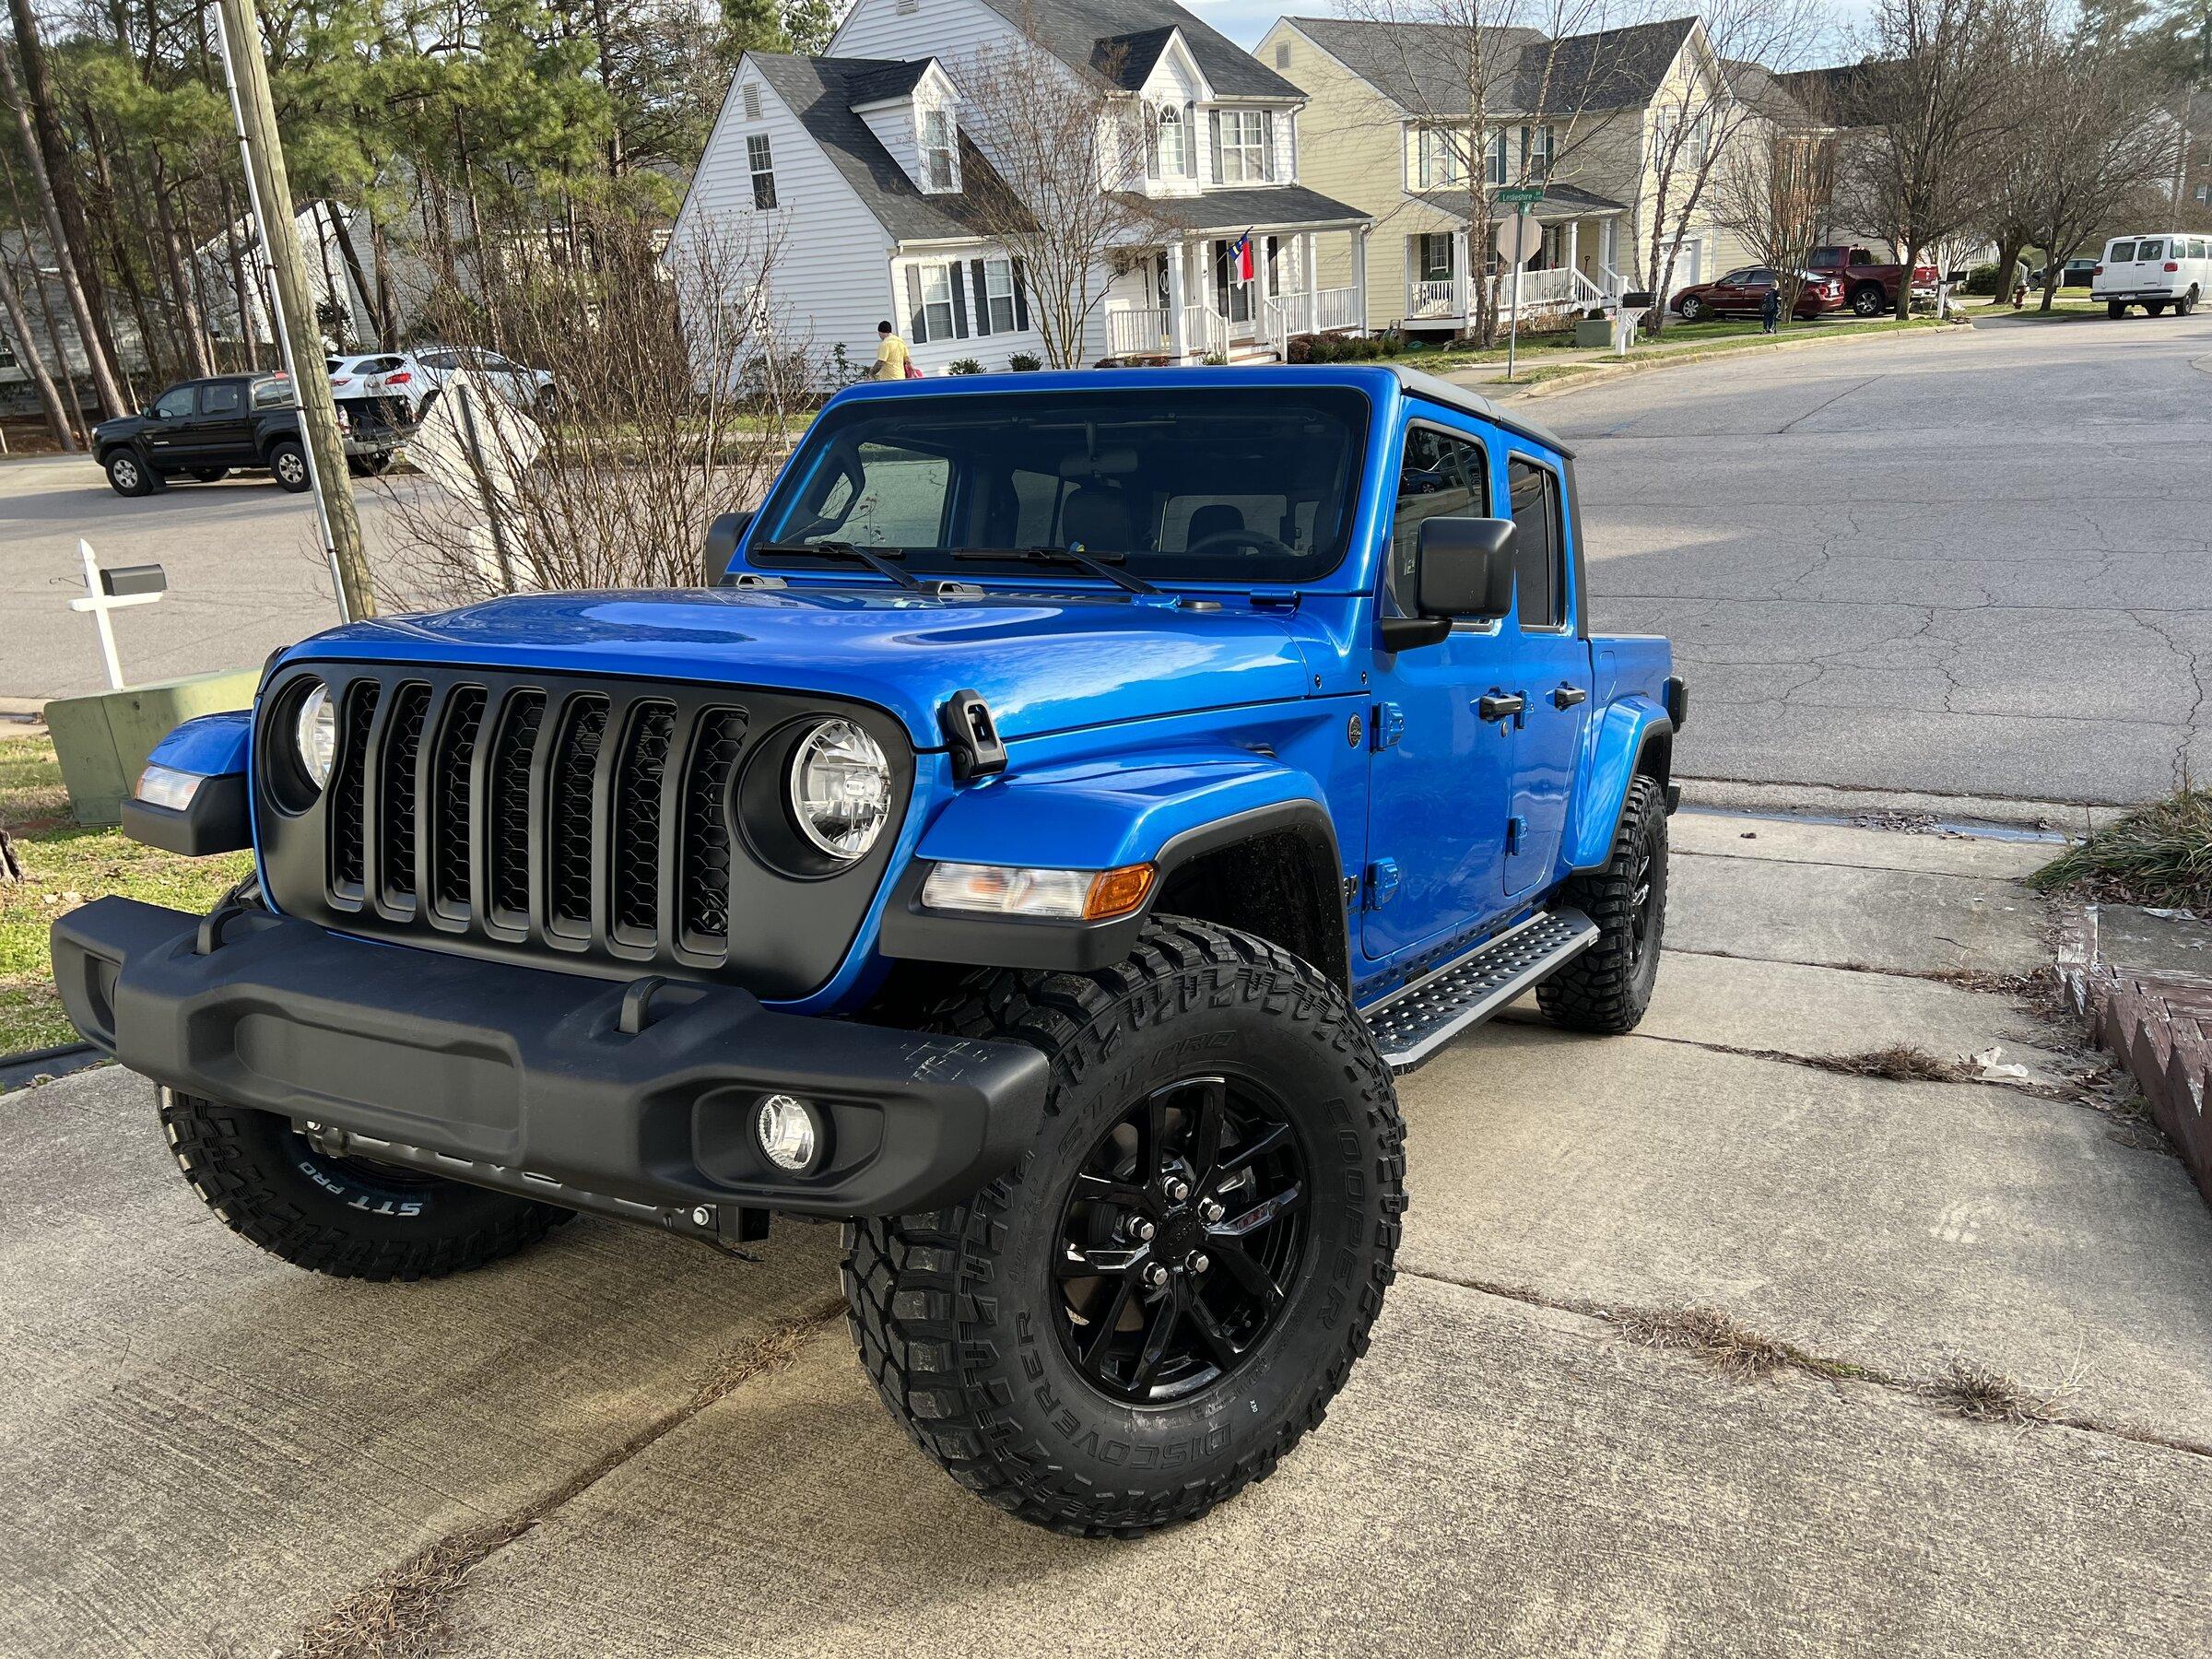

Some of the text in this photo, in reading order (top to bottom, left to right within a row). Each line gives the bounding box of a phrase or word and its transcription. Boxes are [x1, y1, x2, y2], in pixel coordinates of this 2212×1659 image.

[1059, 1030, 1236, 1164] STT PRO
[298, 1161, 423, 1216] STT PRO
[1318, 1097, 1365, 1330] COOPER
[1016, 1309, 1231, 1470] DISCOVERER
